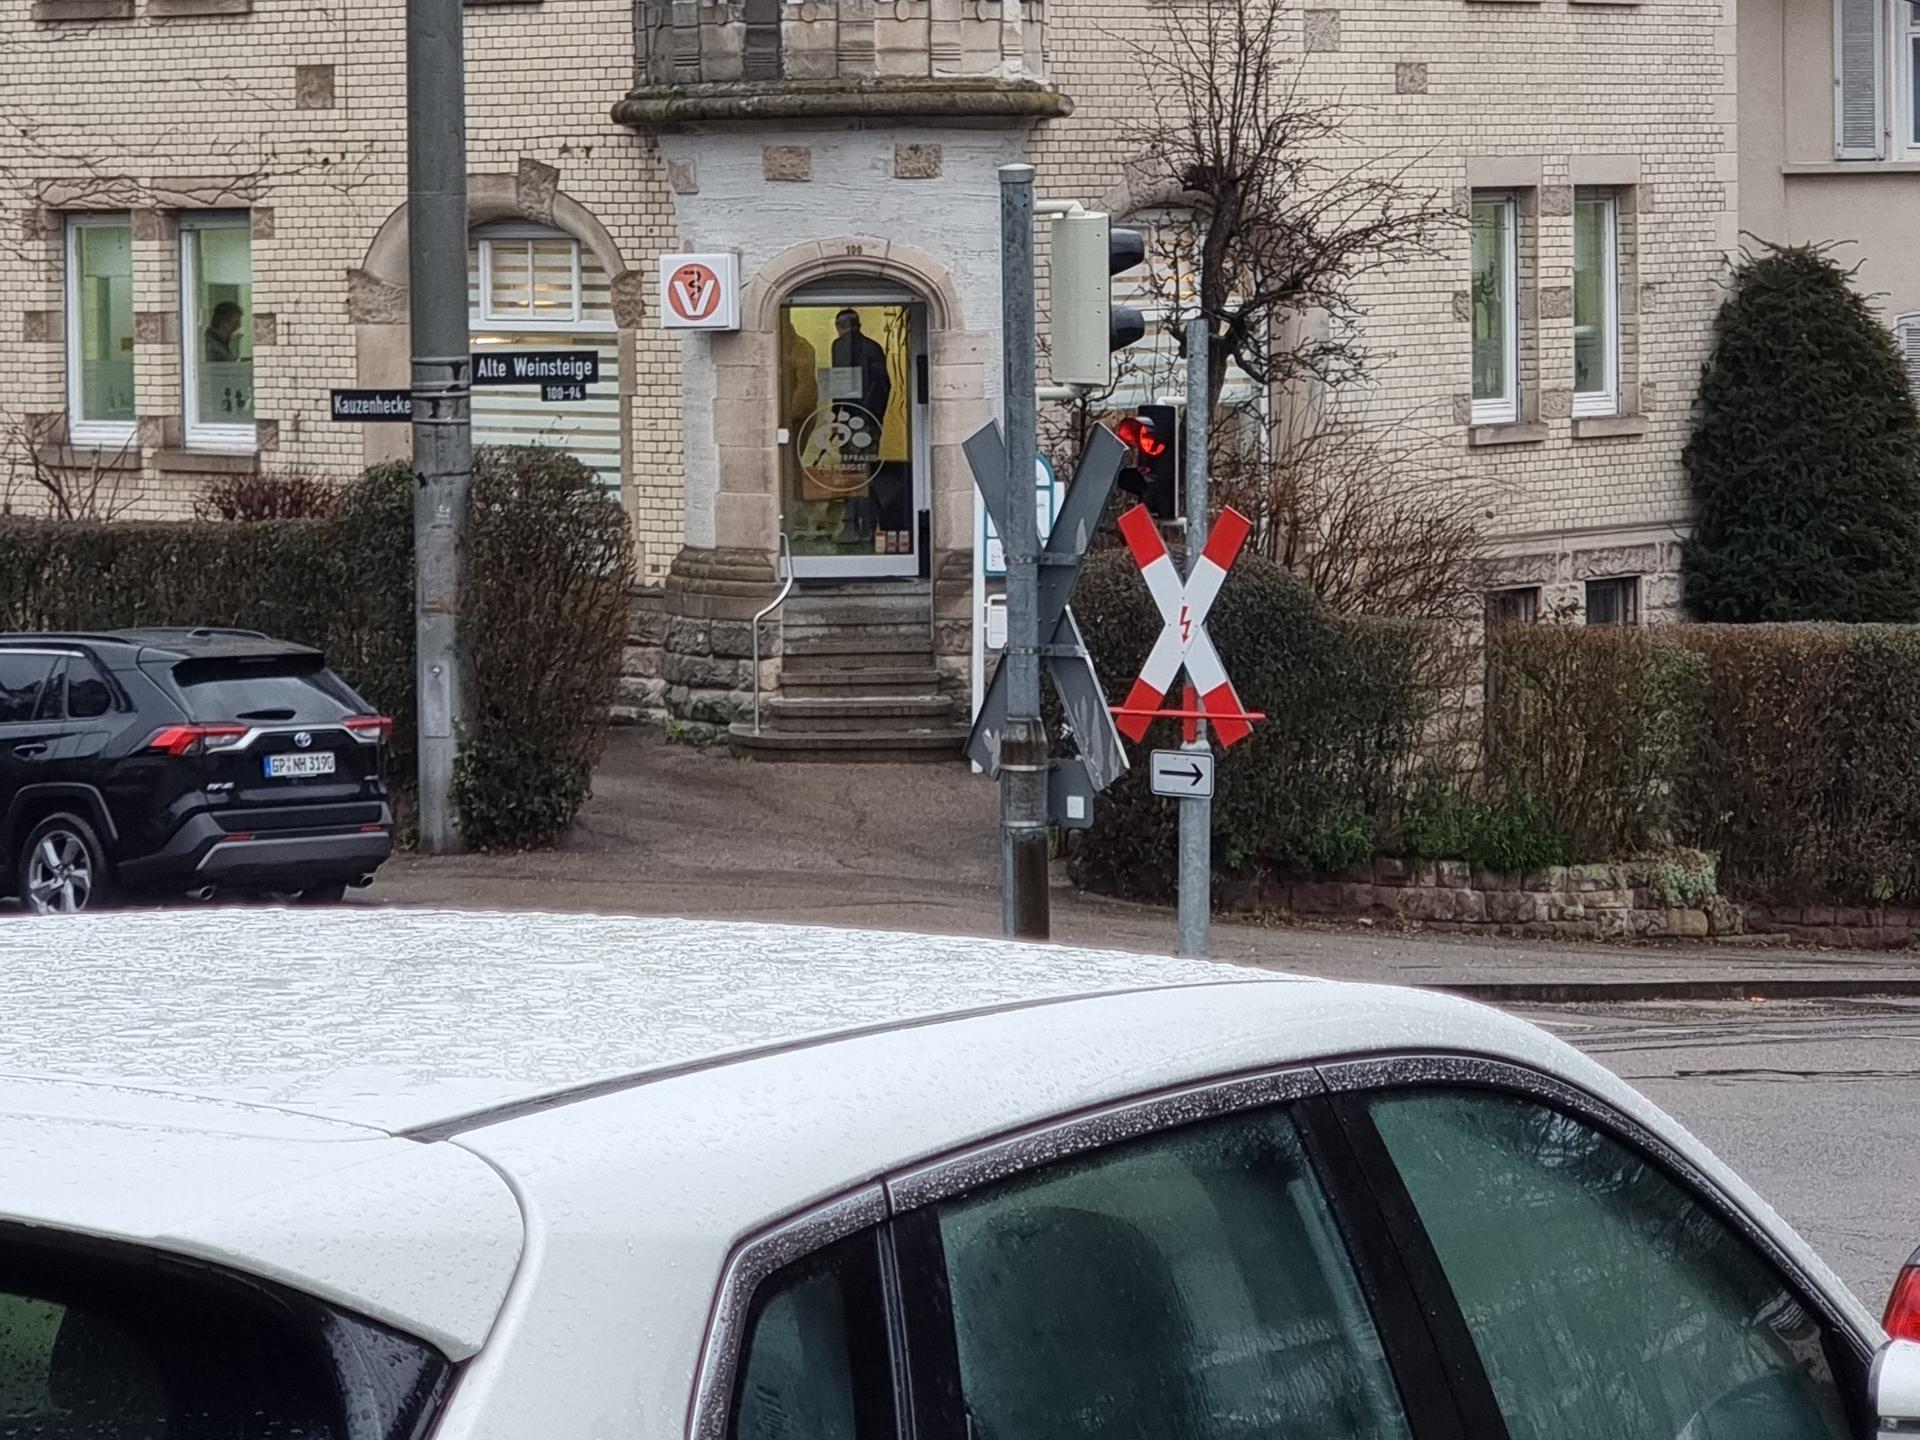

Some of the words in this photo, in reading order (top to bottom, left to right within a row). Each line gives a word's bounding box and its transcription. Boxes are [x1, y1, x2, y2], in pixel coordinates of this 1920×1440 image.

[477, 358, 507, 377] Alte
[513, 357, 592, 380] Weinsteige
[546, 386, 581, 400] 100-94
[334, 394, 411, 414] Kauzenhecke
